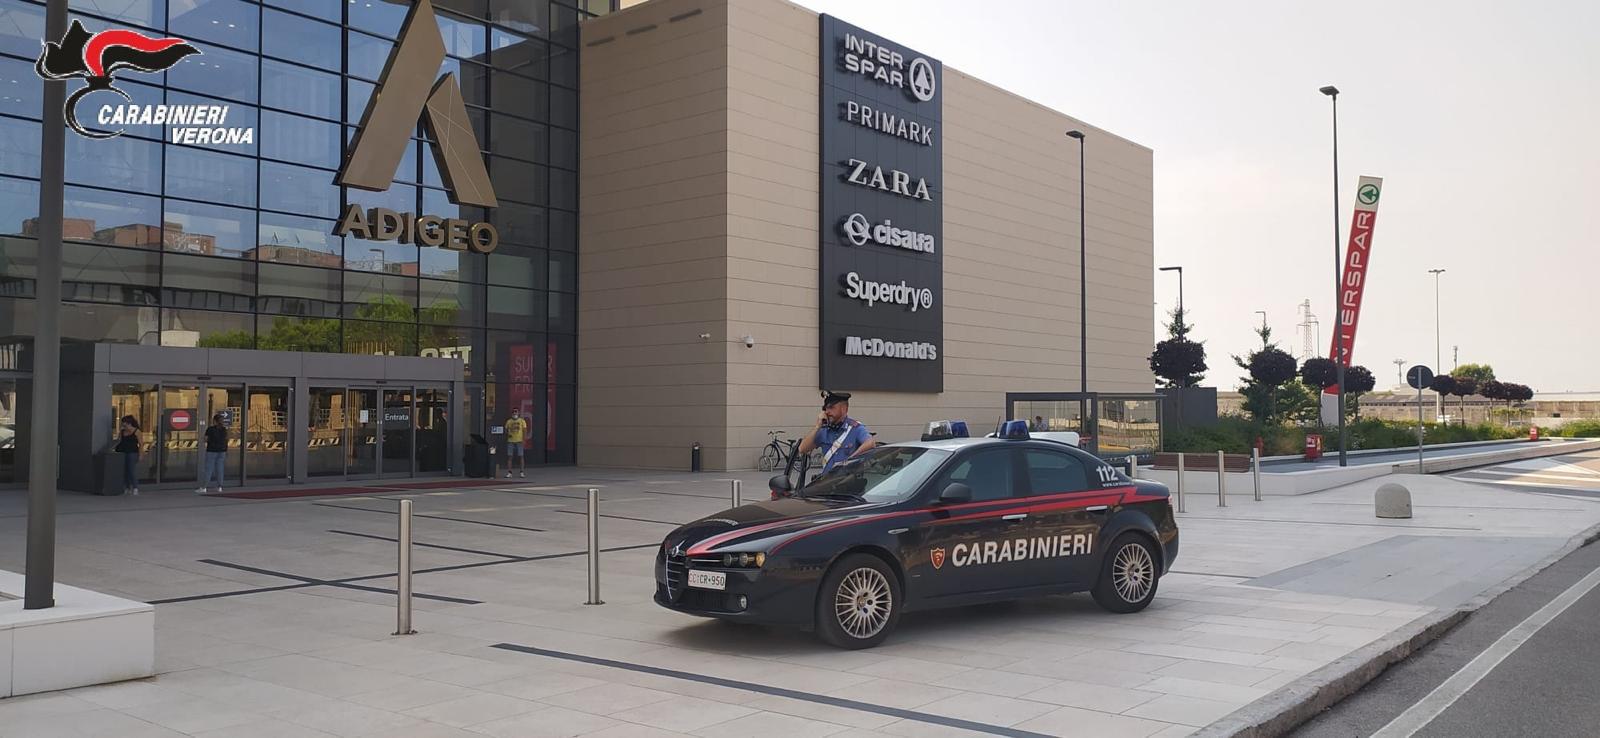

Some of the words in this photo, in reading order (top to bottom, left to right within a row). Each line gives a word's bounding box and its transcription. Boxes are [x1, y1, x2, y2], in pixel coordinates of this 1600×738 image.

[845, 33, 903, 70] INTER
[845, 53, 903, 88] SPAR
[847, 100, 932, 146] PRIMARK
[847, 158, 932, 201] ZARA
[332, 203, 498, 253] ADIGEO
[1333, 211, 1372, 365] NERSPAR
[845, 336, 937, 360] McDonald's
[384, 413, 409, 421] Entrata
[1096, 465, 1119, 482] 112
[951, 533, 1093, 567] CARABINIERI
